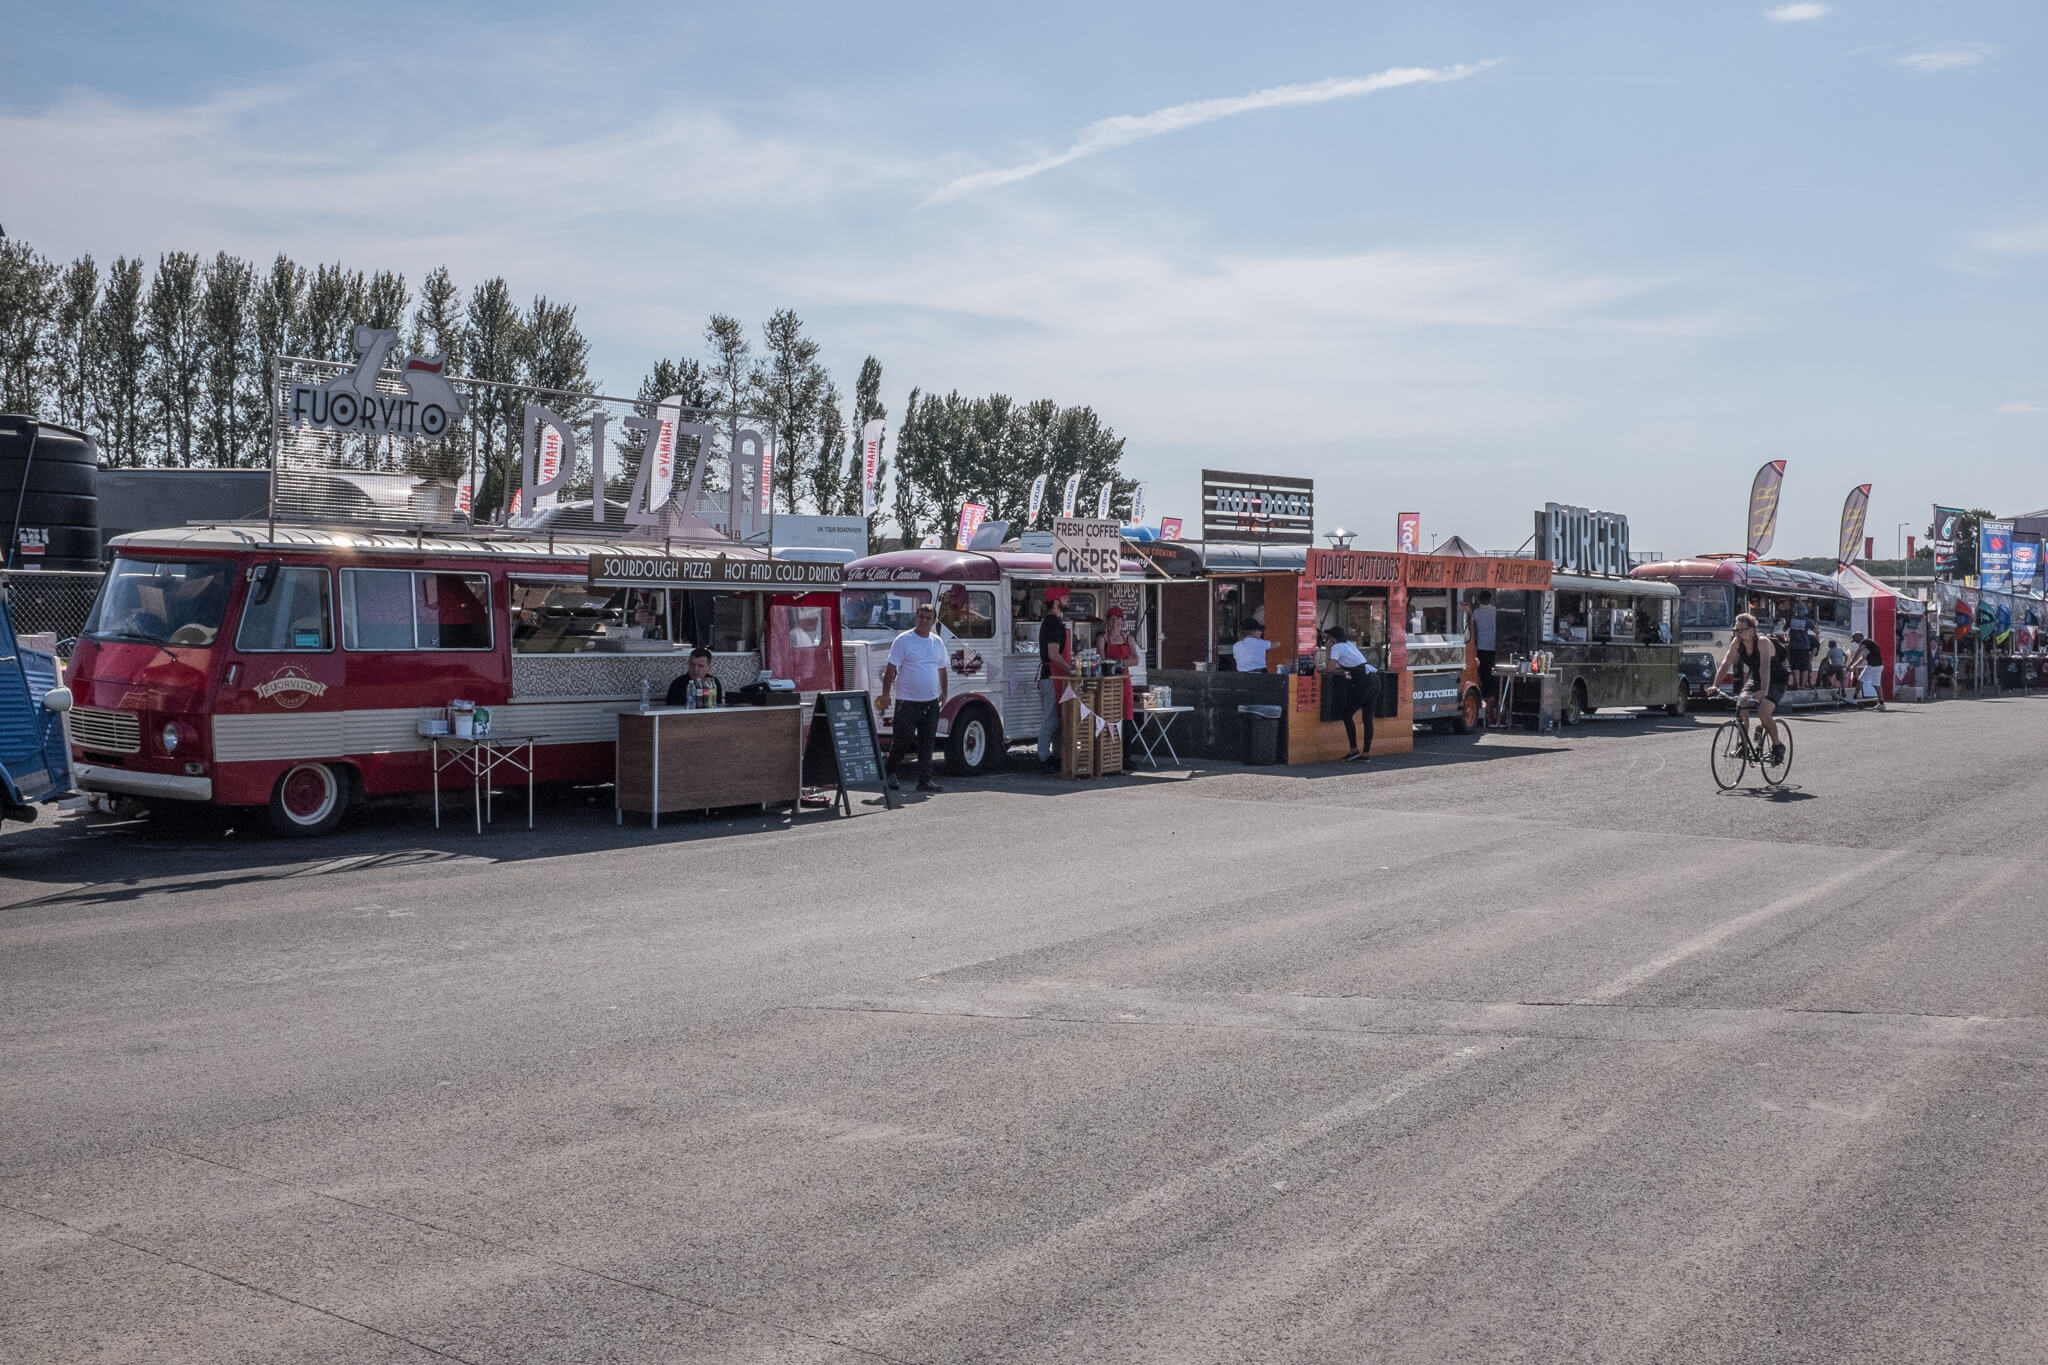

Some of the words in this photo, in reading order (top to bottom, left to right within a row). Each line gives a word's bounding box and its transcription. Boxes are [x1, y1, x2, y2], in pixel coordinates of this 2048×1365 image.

[293, 388, 447, 436] FUORVITO
[543, 433, 560, 482] YAMAHA
[658, 421, 673, 465] YAMAHA
[521, 404, 764, 532] PIZZA
[866, 441, 877, 480] YAMAHA
[1032, 480, 1043, 510] SUZUKI
[1066, 479, 1076, 510] SUZUKI
[1135, 487, 1144, 516] SUZUKI
[1215, 488, 1256, 513] HOT
[1259, 492, 1309, 517] DOGS
[1753, 481, 1779, 539] BAR
[1056, 521, 1084, 538] FRESH
[1085, 523, 1120, 539] COFFEE
[1085, 538, 1091, 548] &
[1546, 503, 1630, 577] BURGER
[1844, 506, 1866, 553] BAR
[603, 558, 679, 579] SOURDOUGH
[683, 561, 712, 579] PIZZA
[725, 563, 747, 580] HOT
[750, 564, 772, 580] AND
[776, 565, 805, 581] COLD
[808, 566, 841, 582] DRINKS
[848, 567, 865, 581] The
[890, 566, 921, 581] Camion
[1055, 547, 1119, 574] CREPES
[1315, 553, 1355, 580] LOADED
[1358, 556, 1401, 582] HOTDOGS
[1409, 559, 1446, 583] CHICKEN
[1495, 562, 1527, 586] FALAFEL
[1526, 565, 1552, 587] WRAPS
[1112, 583, 1136, 599] CREPES
[263, 679, 319, 695] FUORVITOS
[1424, 688, 1459, 699] KITCHEN
